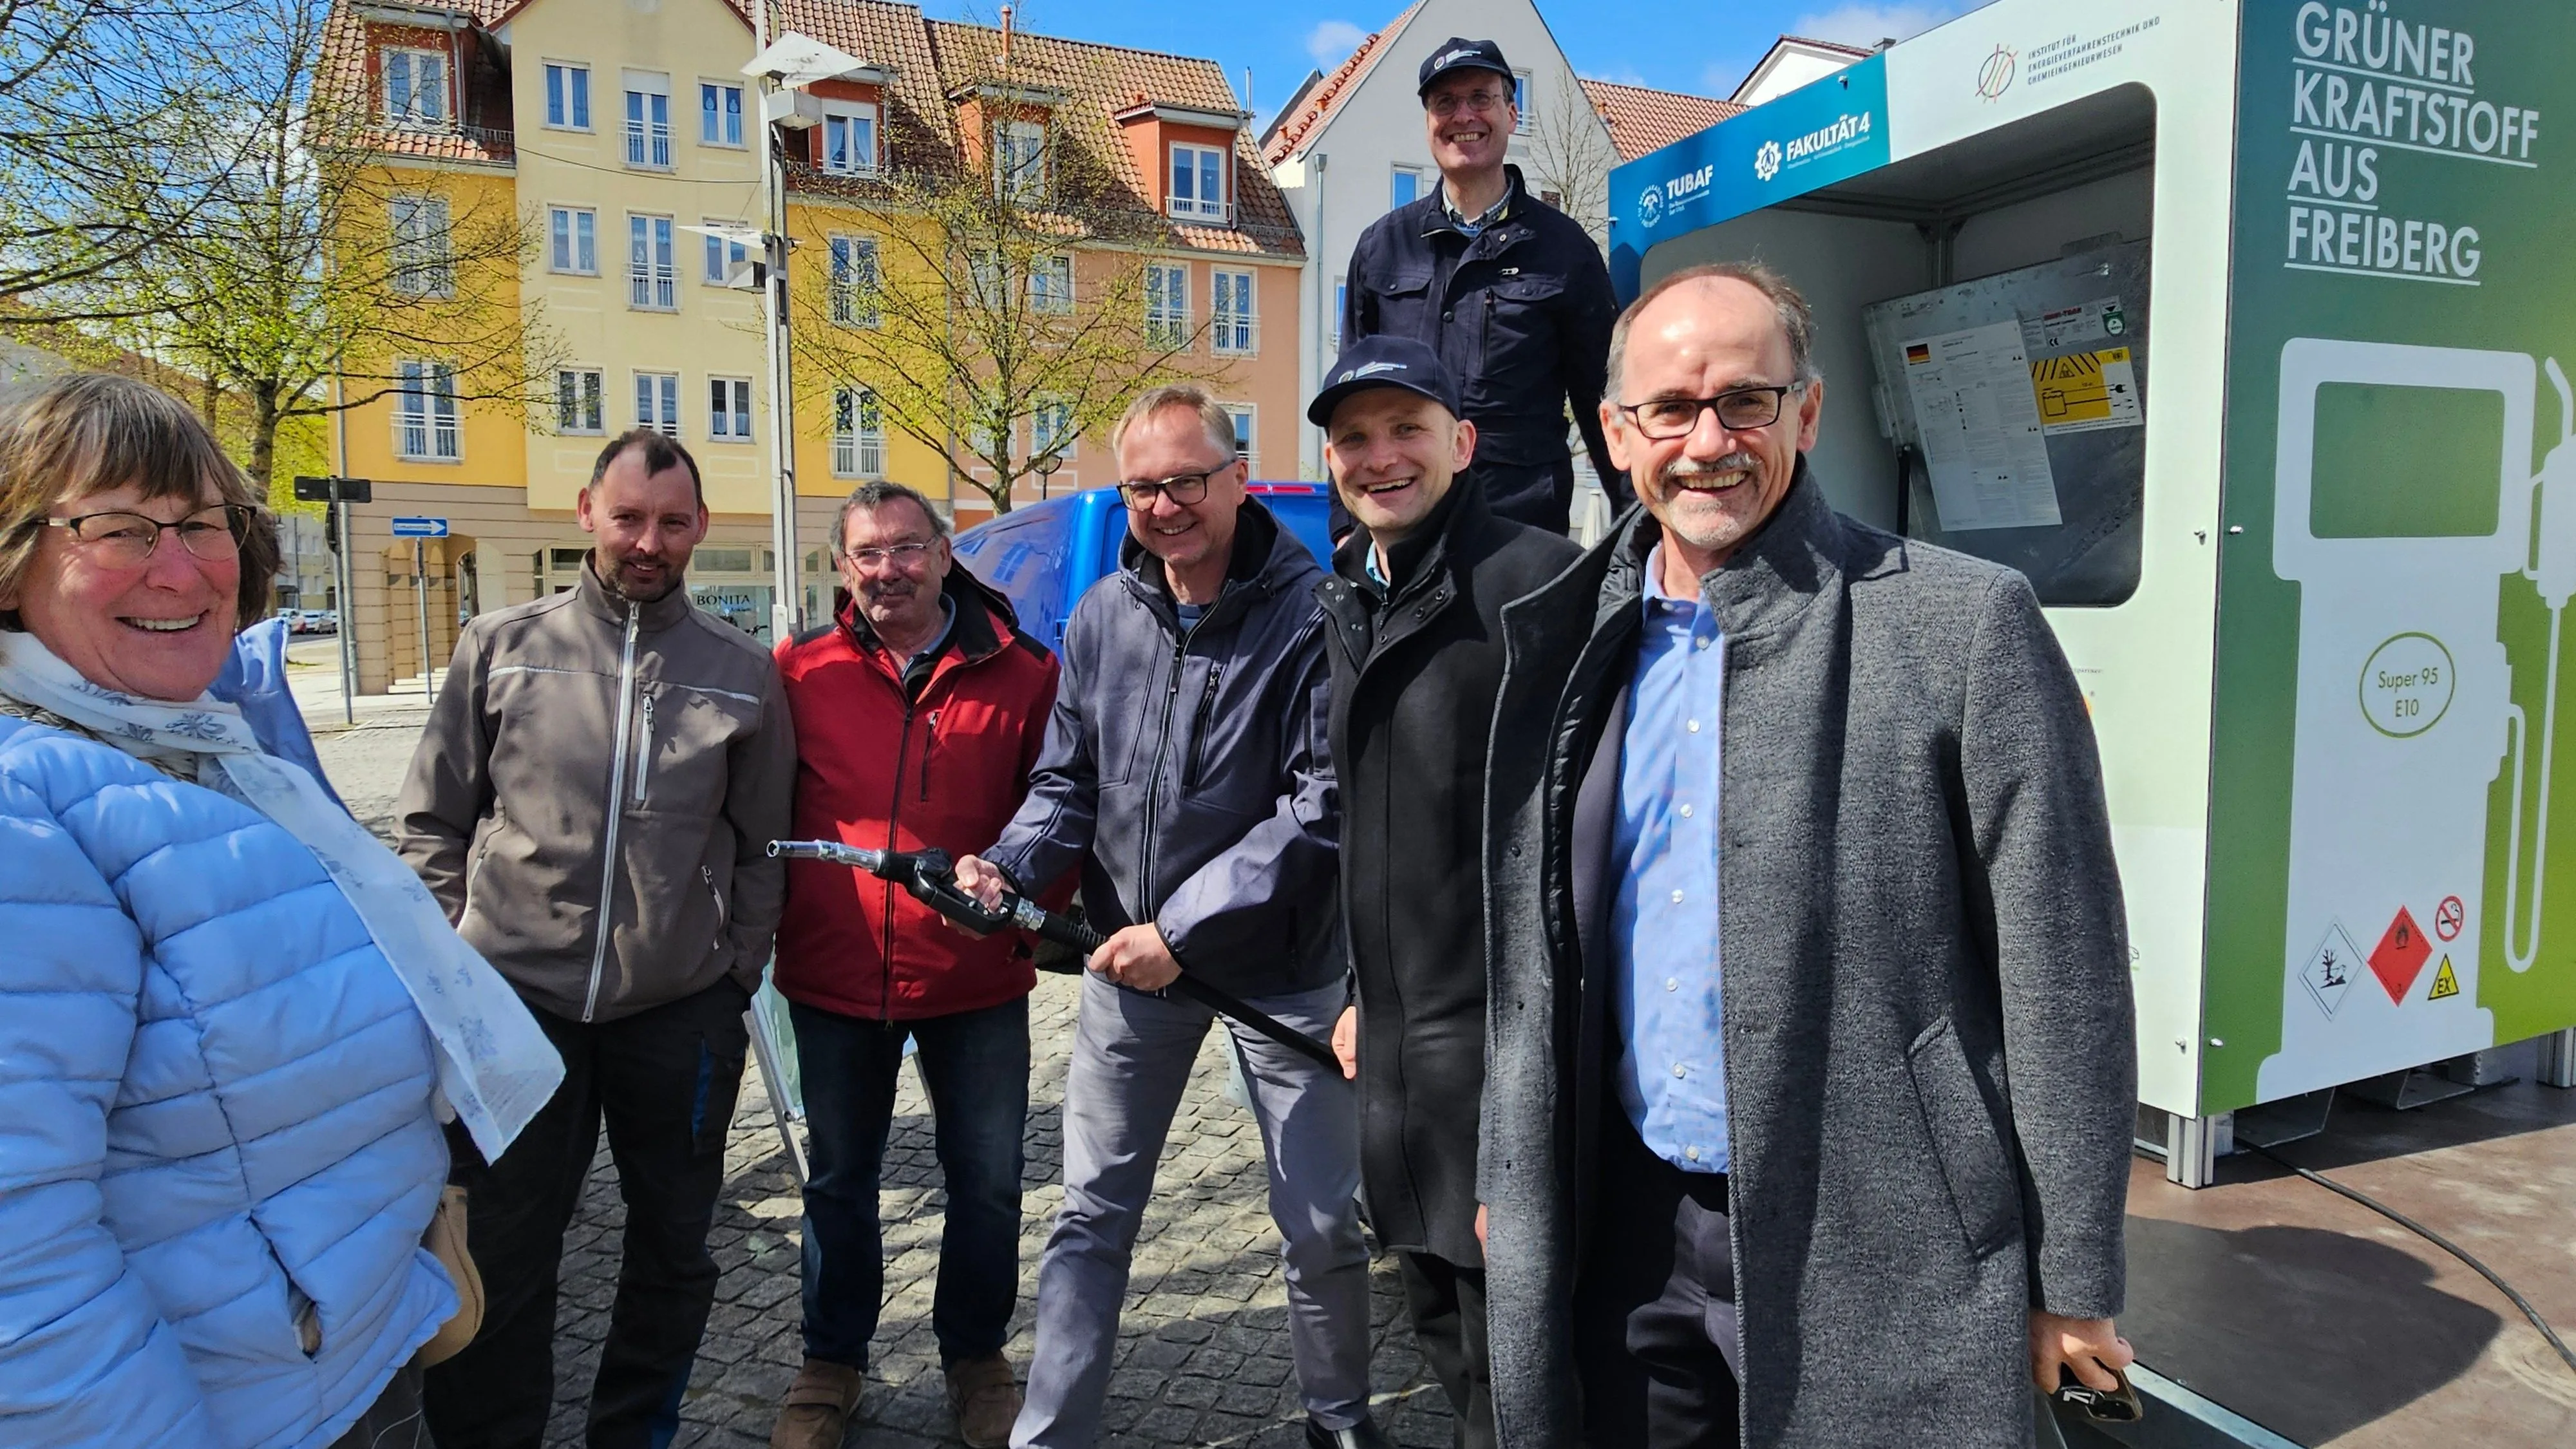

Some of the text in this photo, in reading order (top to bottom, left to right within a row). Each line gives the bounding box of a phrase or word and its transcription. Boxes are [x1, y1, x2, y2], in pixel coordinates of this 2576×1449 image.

[2028, 15, 2161, 73] ENERGIEVERFAHRENSTECHNIK UND
[2028, 33, 2077, 60] INSTITUT FÜR
[2295, 0, 2474, 85] GRÜNER
[2293, 68, 2539, 158] KRAFTSTOFF
[1786, 113, 1859, 162] FAKULTÄT
[1859, 111, 1871, 133] 4
[1666, 164, 1714, 200] TUBAF
[2287, 139, 2378, 202] AUS
[2287, 206, 2481, 278] FREIBERG
[697, 594, 750, 605] BONITA
[2378, 667, 2438, 694] Super 95
[2395, 697, 2420, 718] E10
[2437, 976, 2451, 994] EX
